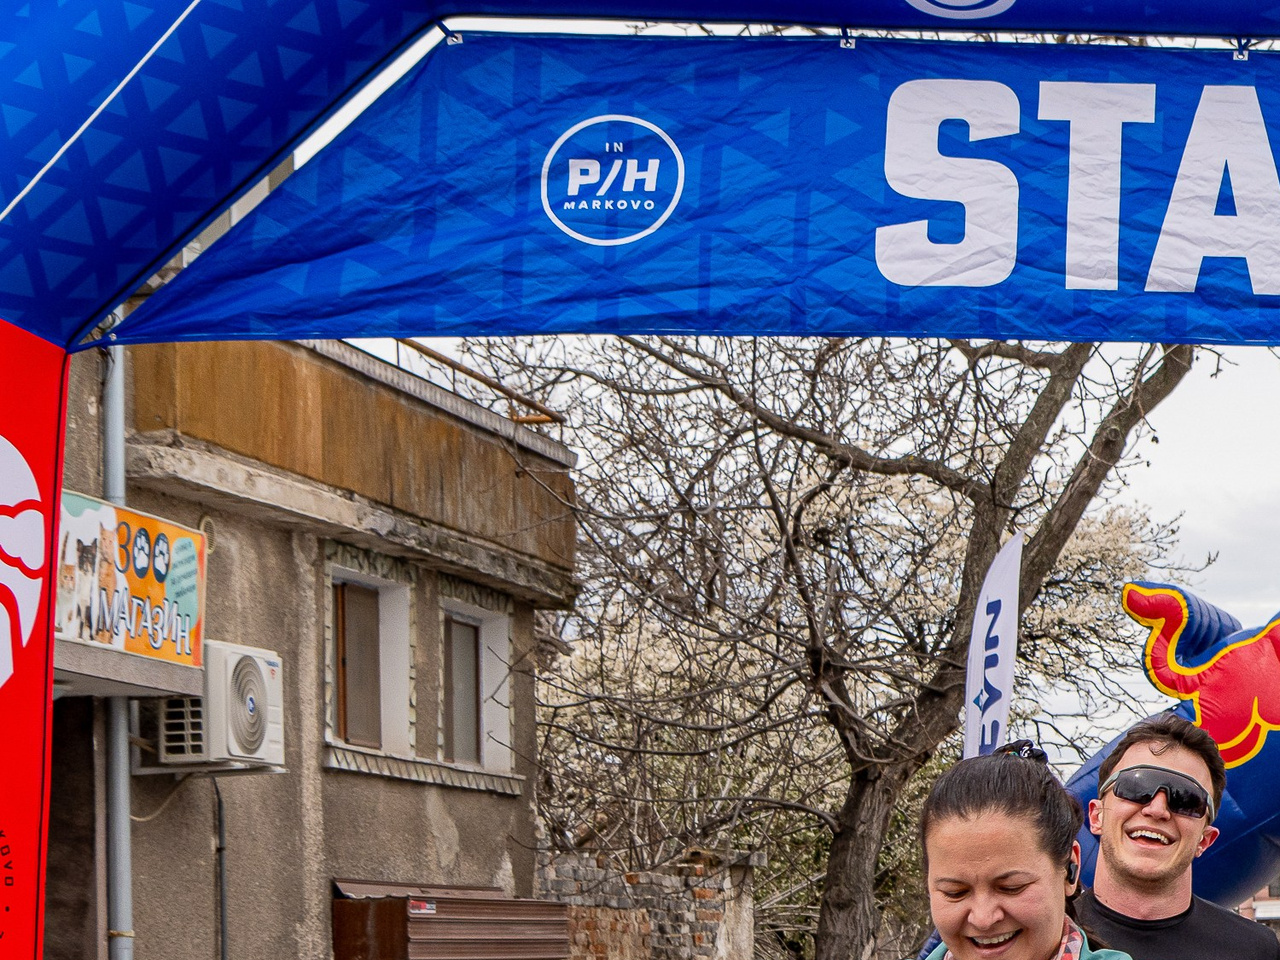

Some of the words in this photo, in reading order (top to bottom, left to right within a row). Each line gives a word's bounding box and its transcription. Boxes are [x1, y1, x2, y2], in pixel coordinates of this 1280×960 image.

[605, 142, 623, 153] IN
[567, 158, 660, 197] P/H
[563, 199, 655, 210] MARKOVO
[98, 587, 191, 655] МАГАЗИН
